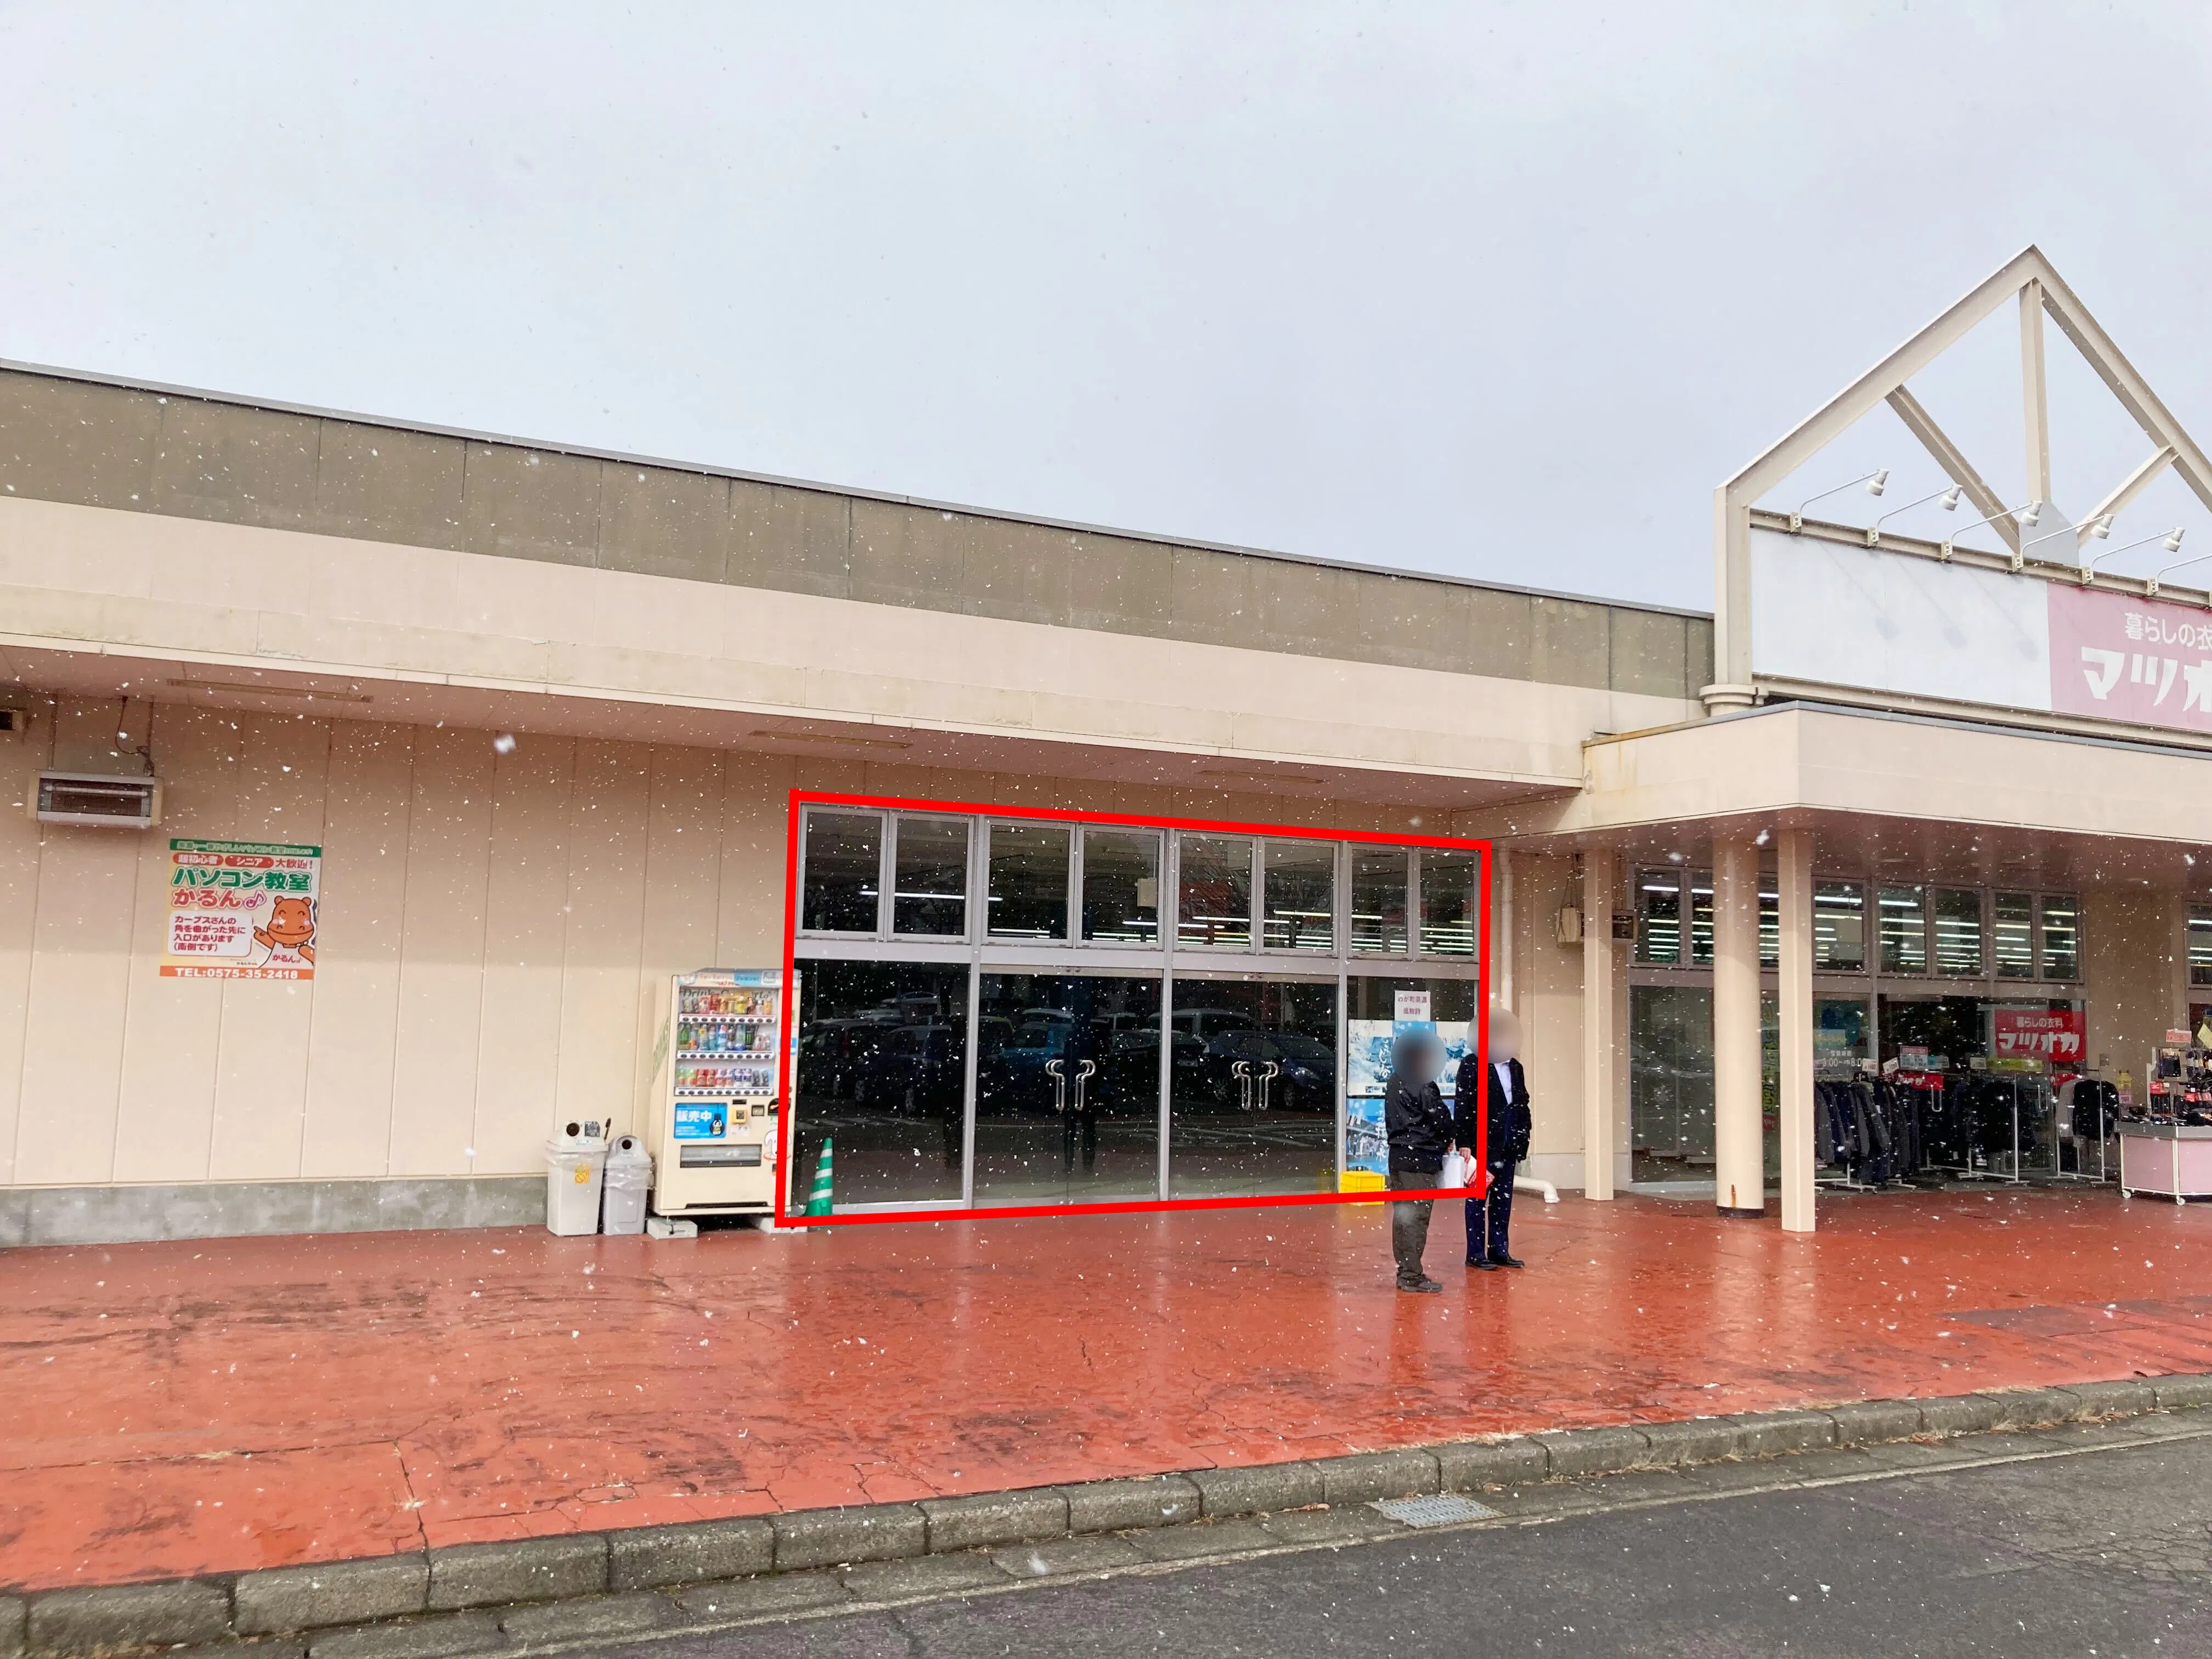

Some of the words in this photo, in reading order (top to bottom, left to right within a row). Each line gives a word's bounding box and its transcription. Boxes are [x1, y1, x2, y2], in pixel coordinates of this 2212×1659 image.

[236, 856, 263, 866] シニア
[172, 868, 311, 891] パソコン教室
[174, 916, 236, 924] カーブスさんの
[174, 924, 246, 934] 角を曲がった先に
[173, 934, 234, 943] 入口があります
[175, 968, 298, 979] TEL:0575-35-2418
[2016, 1016, 2064, 1029] 暮らしの衣料
[1998, 1031, 2080, 1055] マツオカ
[676, 1110, 713, 1123] 販売中
